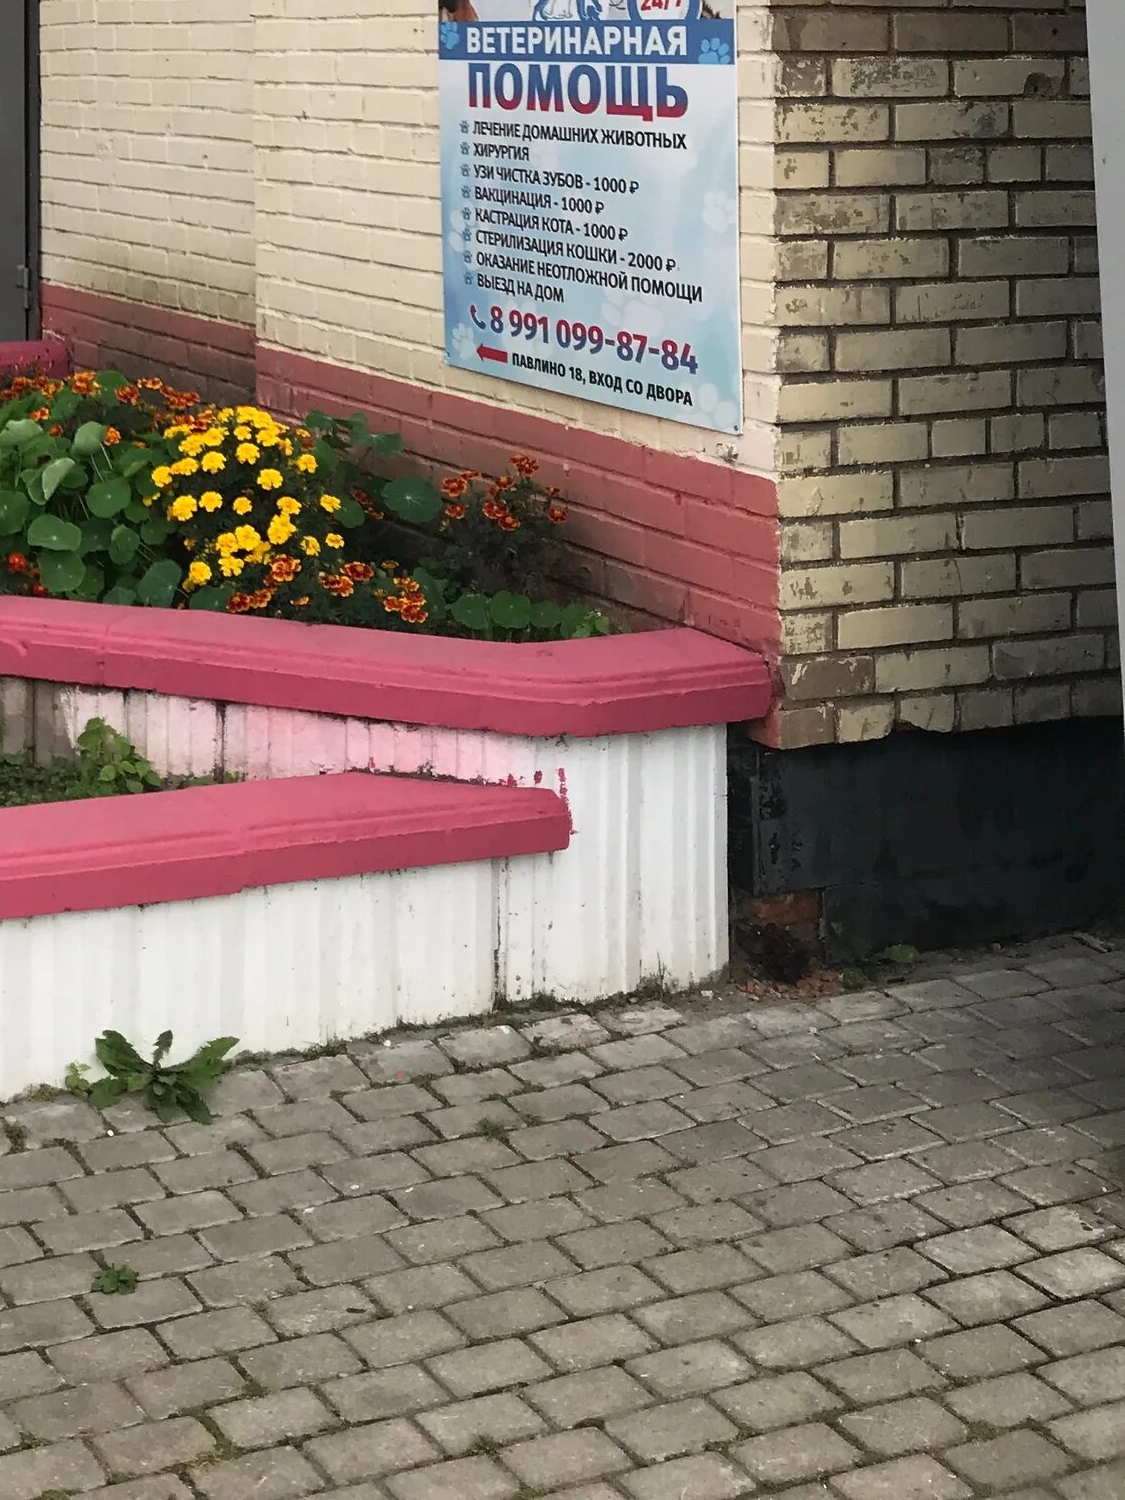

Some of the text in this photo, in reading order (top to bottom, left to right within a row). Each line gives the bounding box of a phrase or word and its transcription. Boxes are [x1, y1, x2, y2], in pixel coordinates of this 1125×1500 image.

[467, 26, 687, 56] ВЕТЕРИНАРНАЯ
[468, 62, 688, 122] ПОМОЩЬ
[472, 121, 687, 149] ЛЕЧЕНИЕ ДОМАШНИХ ЖИВОТНЫХ
[473, 144, 529, 161] ХИРУРГИЯ
[474, 165, 495, 180] УЗИ
[497, 166, 541, 184] ЧИСТКА
[543, 171, 583, 188] ЗУБОВ
[594, 177, 626, 192] 1000
[475, 186, 551, 210] ВАКЦИНАЦИЯ
[562, 198, 592, 213] 1000
[475, 208, 539, 231] КАСТРАЦИЯ
[543, 217, 573, 234] КОТА
[583, 223, 615, 240] 1000
[476, 229, 563, 256] СТЕРИЛИЗАЦИЯ
[566, 243, 617, 264] КОШКИ
[628, 252, 662, 271] 2000
[477, 252, 703, 303] ОКАЗАНИЕ НЕОТЛОЖНОЙ ПОМОЩИ
[477, 274, 564, 302] ВЫЕЗД НА ДОМ
[490, 306, 698, 374] 8 991 099-87-84
[513, 352, 693, 406] ПАВЛИНО 18, ВХОД СО ДВОРА
